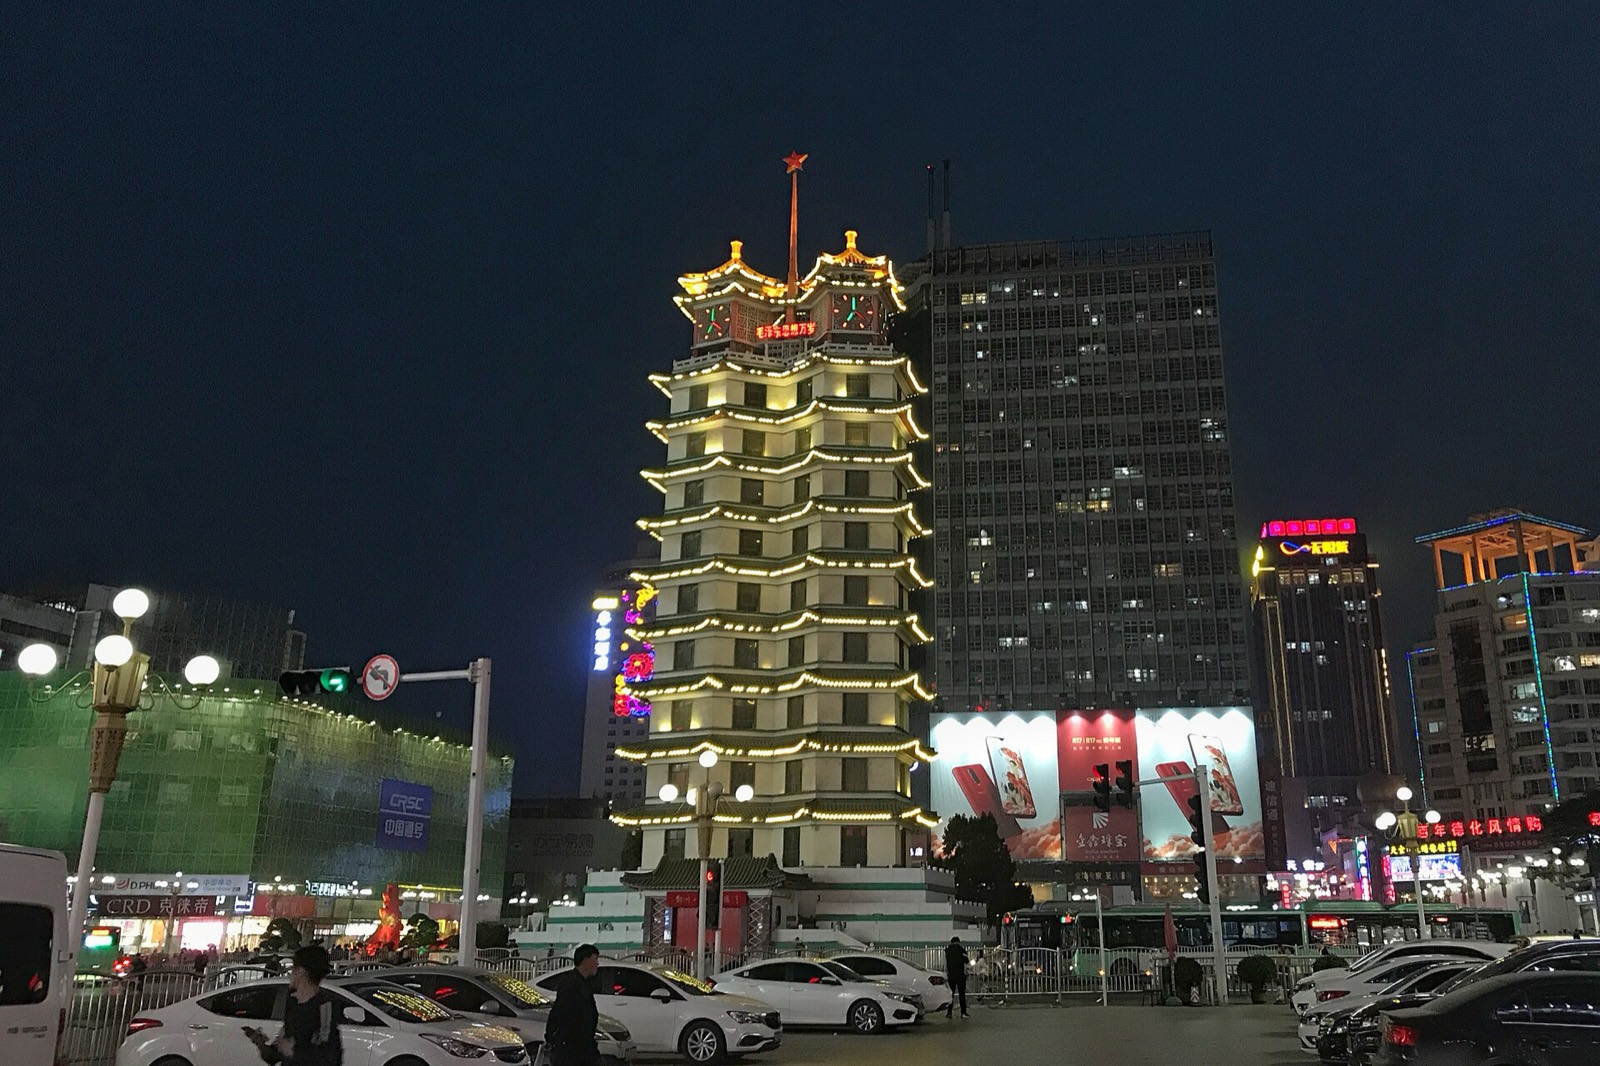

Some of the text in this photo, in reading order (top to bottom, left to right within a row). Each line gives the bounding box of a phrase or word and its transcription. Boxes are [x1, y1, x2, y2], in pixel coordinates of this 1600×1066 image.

[756, 322, 816, 339] 毛泽东思想万岁
[390, 794, 424, 813] CRSC
[385, 818, 424, 839] 中国通号
[106, 898, 151, 914] CRD
